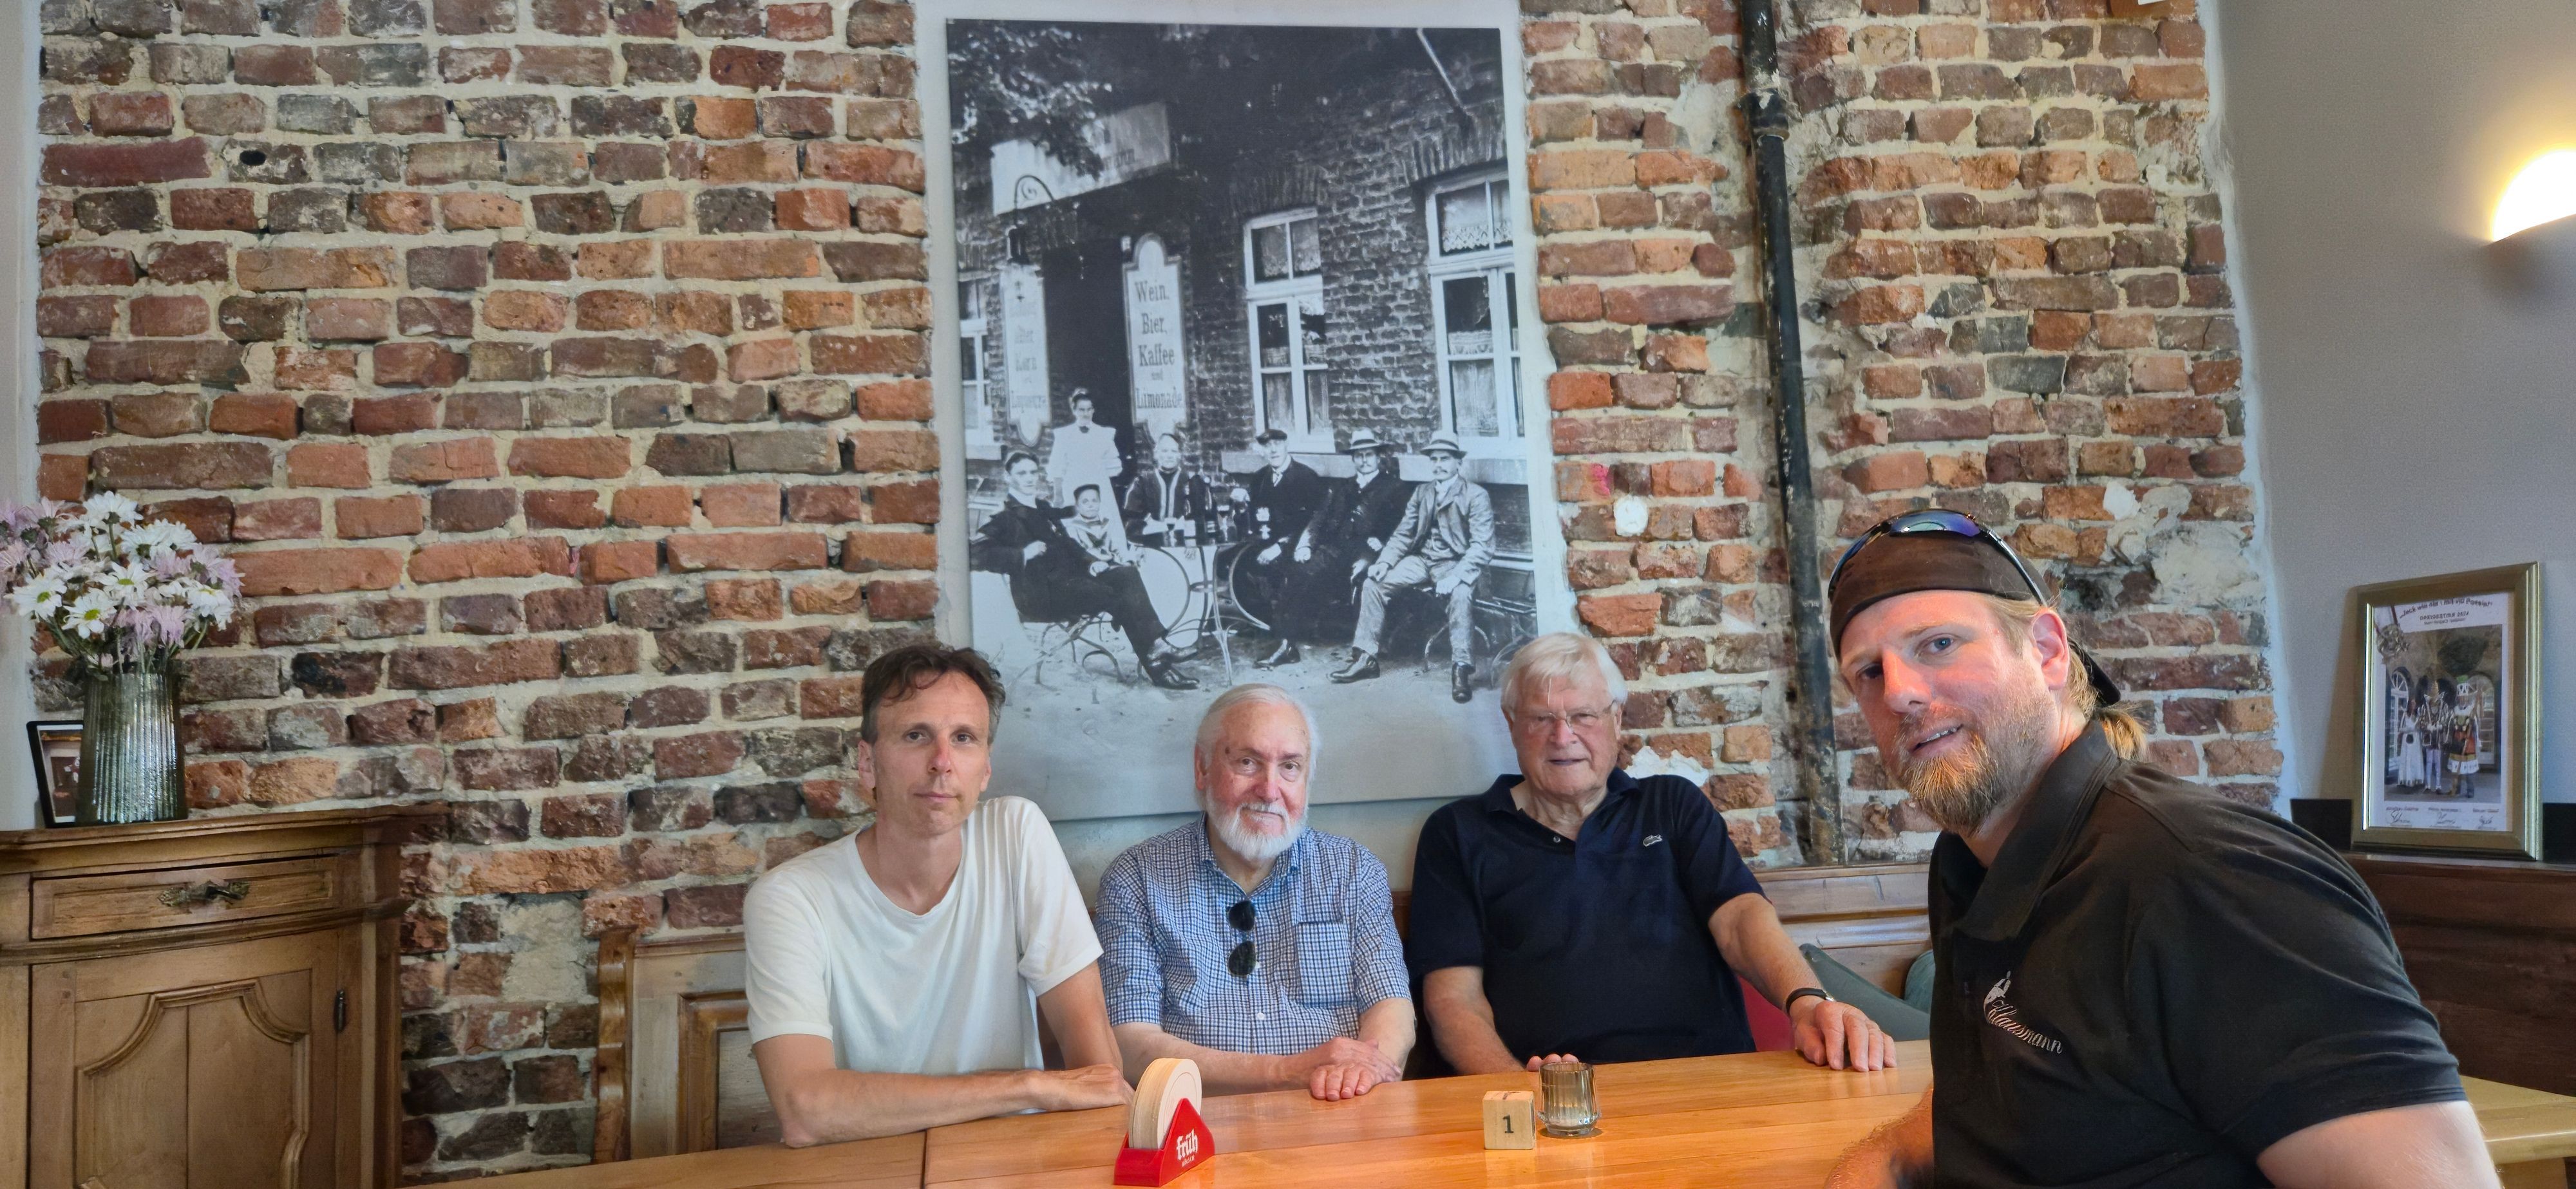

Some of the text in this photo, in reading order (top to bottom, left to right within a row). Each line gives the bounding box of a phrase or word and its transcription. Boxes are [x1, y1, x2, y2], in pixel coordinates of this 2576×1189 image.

[1138, 343, 1175, 367] Kaffee
[1987, 999, 2063, 1054] Klausmann
[1502, 1114, 1515, 1134] 1
[1176, 1128, 1198, 1161] früh
